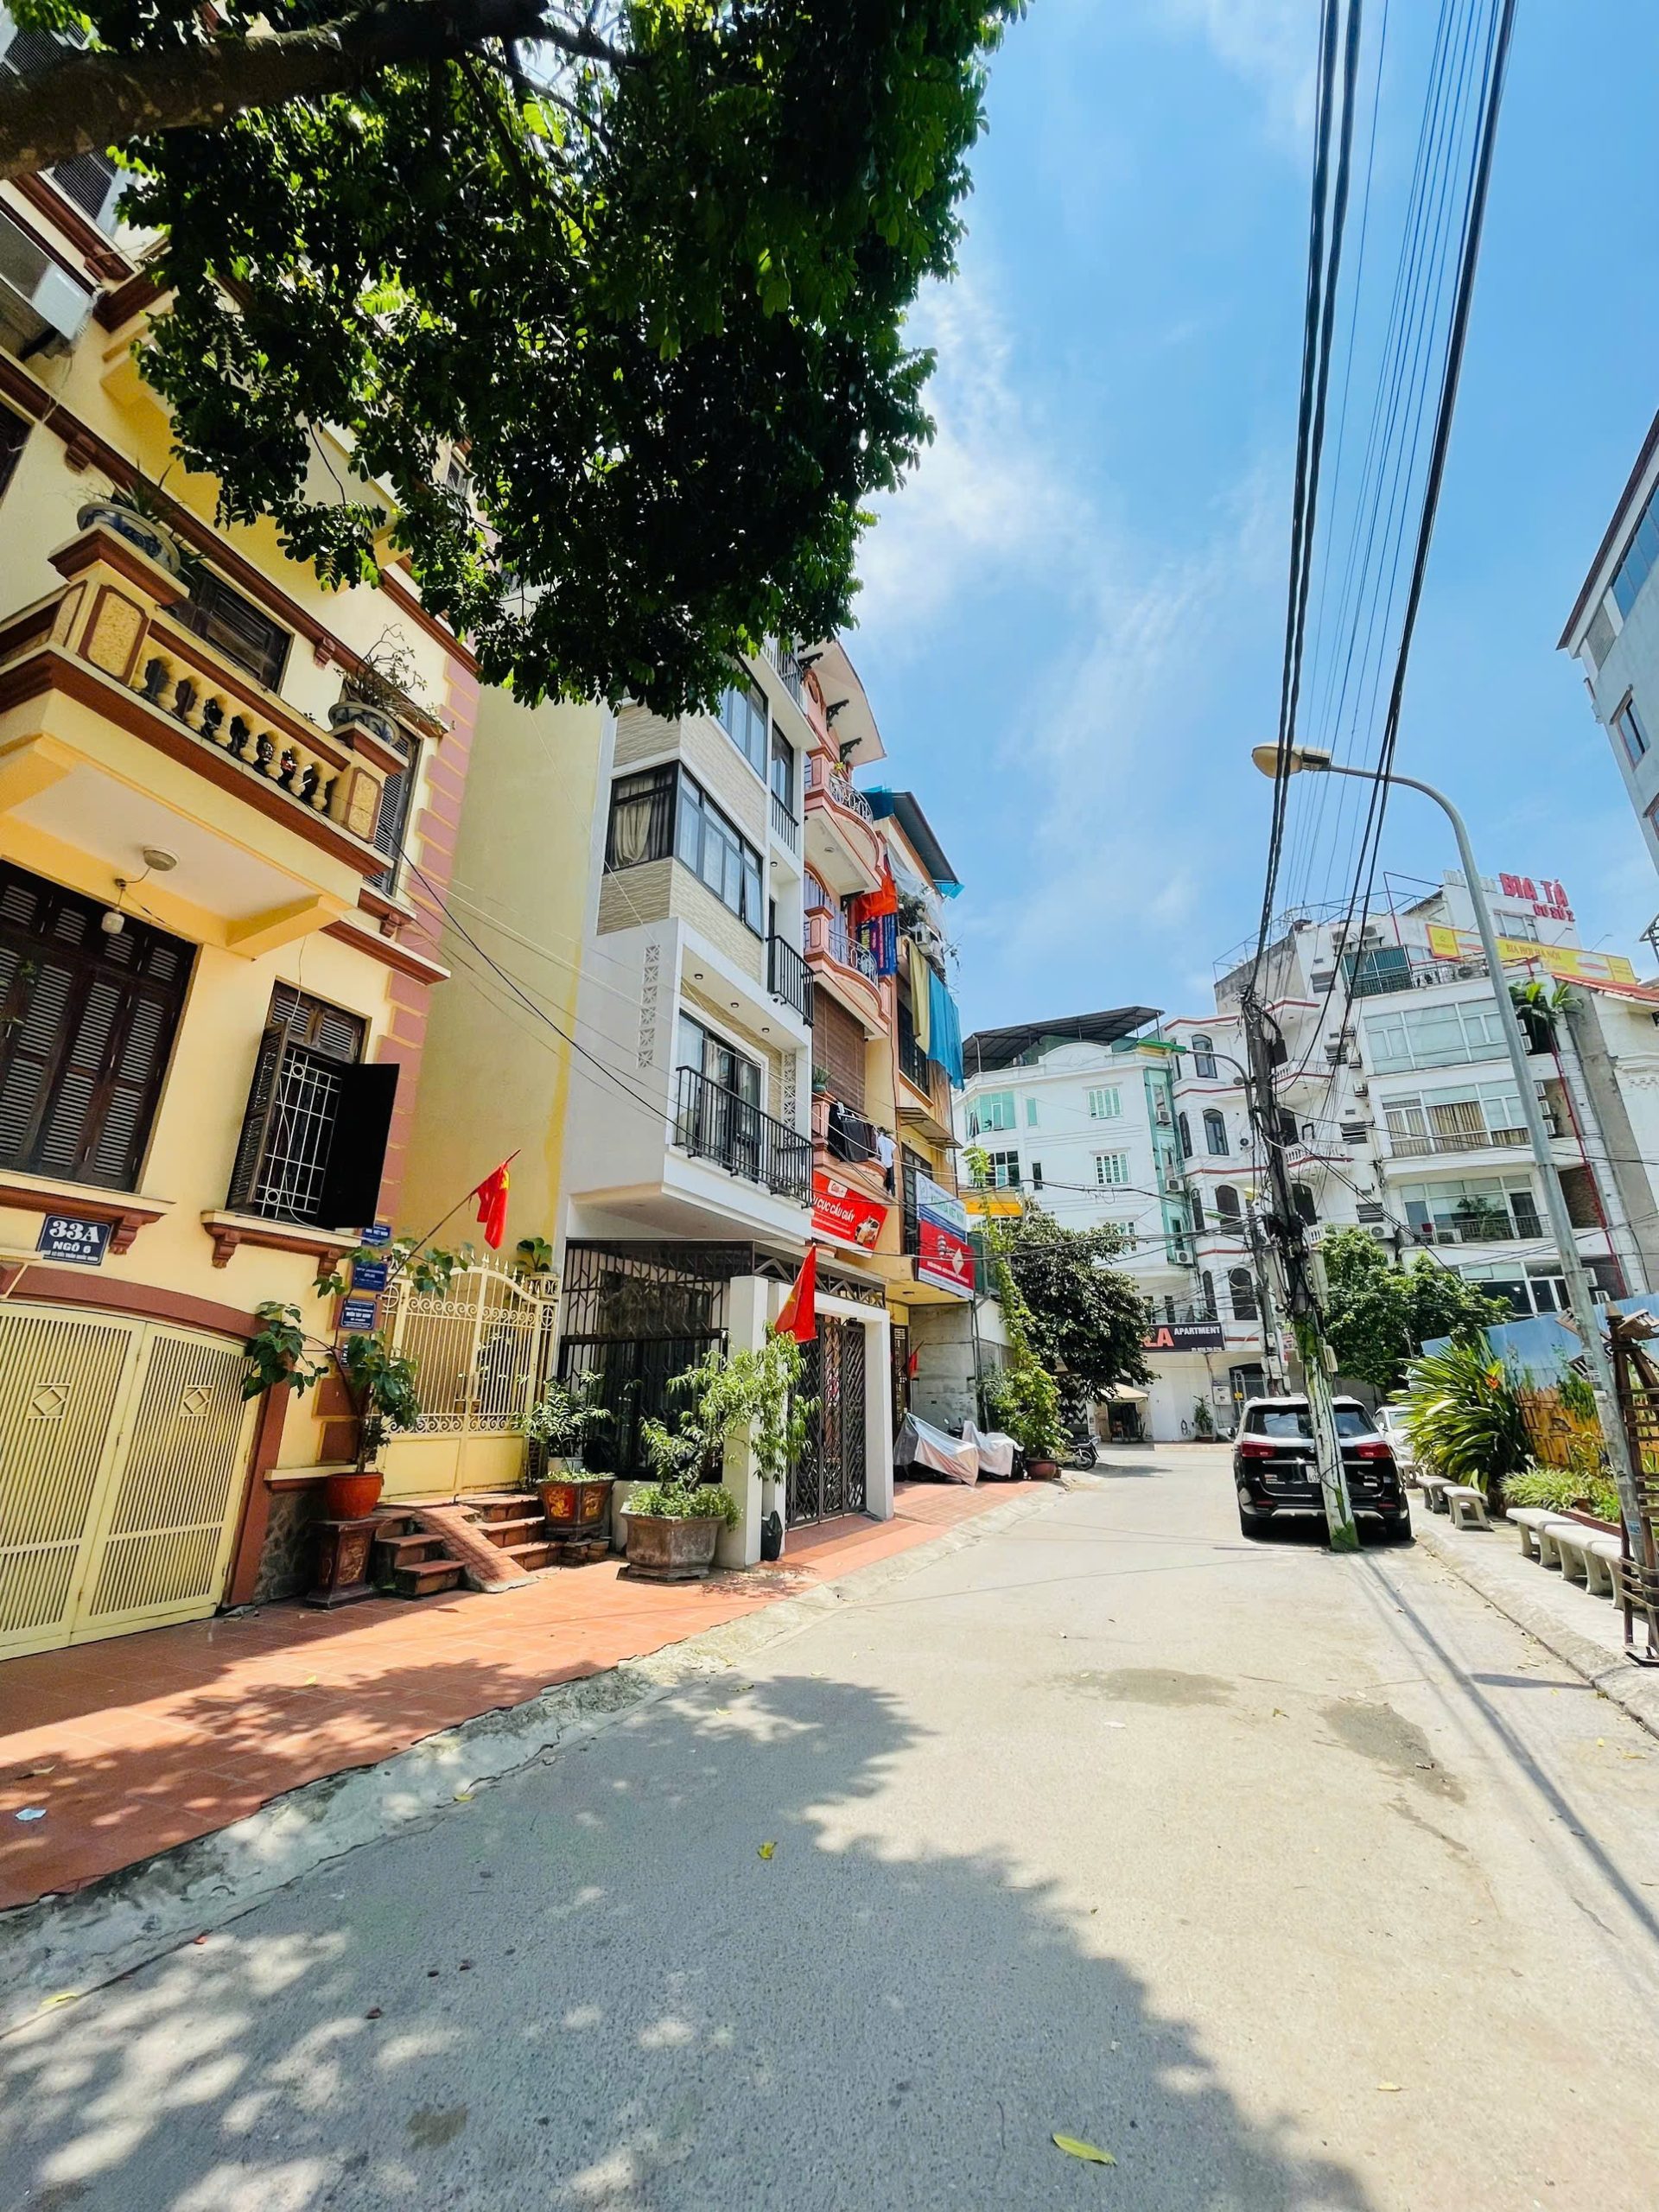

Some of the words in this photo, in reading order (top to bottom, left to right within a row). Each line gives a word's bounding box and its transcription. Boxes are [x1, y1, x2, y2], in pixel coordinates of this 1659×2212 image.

[1498, 873, 1538, 900] BIA
[49, 1220, 100, 1243] 33A
[83, 1245, 92, 1254] 6
[1174, 1326, 1220, 1335] APARTMENT
